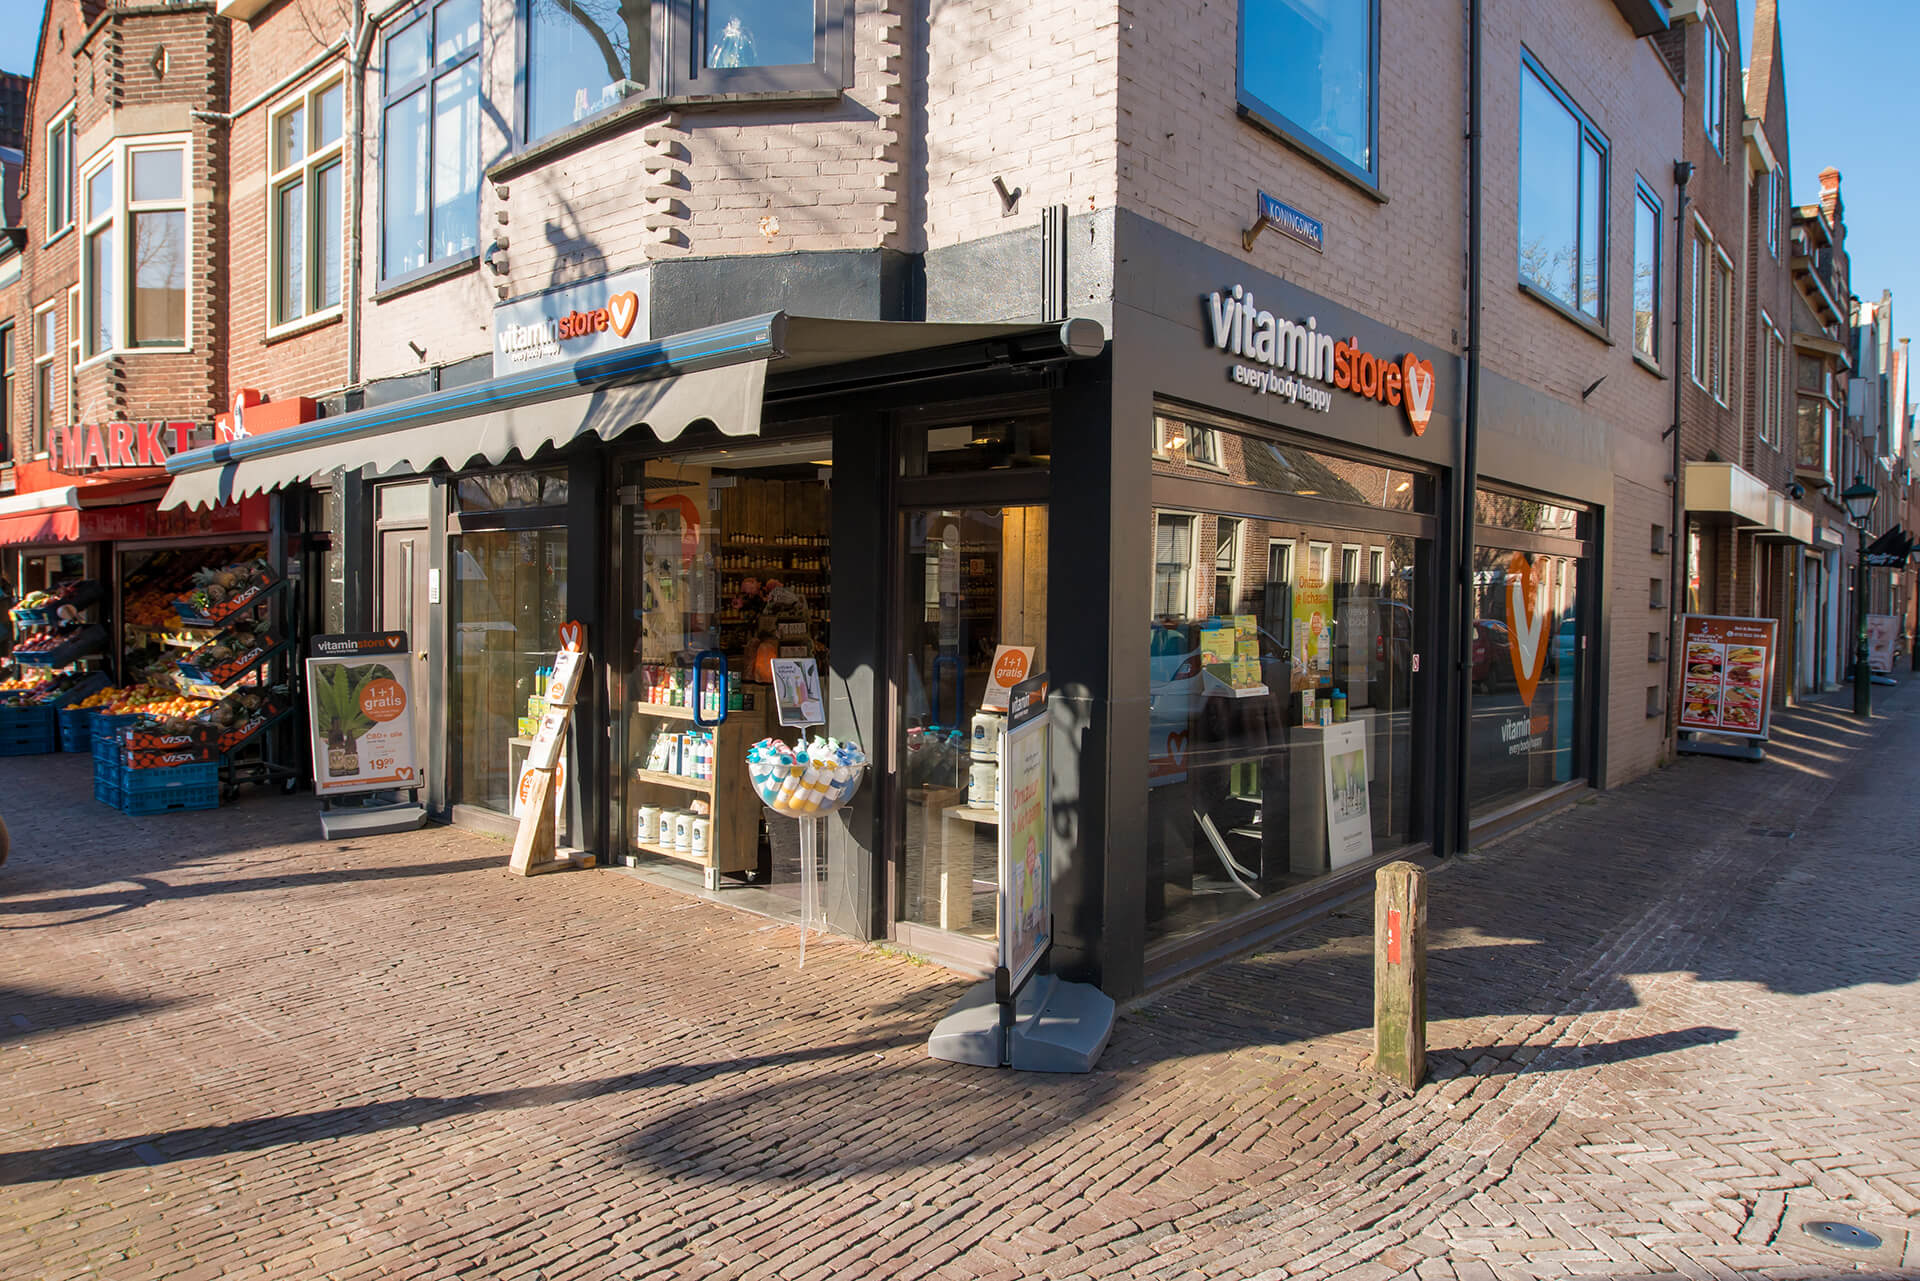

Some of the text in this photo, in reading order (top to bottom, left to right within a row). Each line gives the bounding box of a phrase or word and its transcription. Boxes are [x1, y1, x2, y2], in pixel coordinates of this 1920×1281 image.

[1268, 202, 1319, 242] KONINGSWEG
[498, 307, 610, 353] vitaminstore
[1209, 283, 1402, 407] vitaminstore
[1233, 364, 1332, 413] every body happy
[62, 420, 198, 468] MARKT
[232, 585, 261, 605] VISA
[235, 646, 264, 666] VISA
[1003, 656, 1022, 667] 1+1
[996, 667, 1023, 678] gratis
[364, 695, 402, 711] gratis
[239, 715, 268, 735] VISA
[160, 735, 193, 745] VISA
[161, 752, 195, 763] VISA
